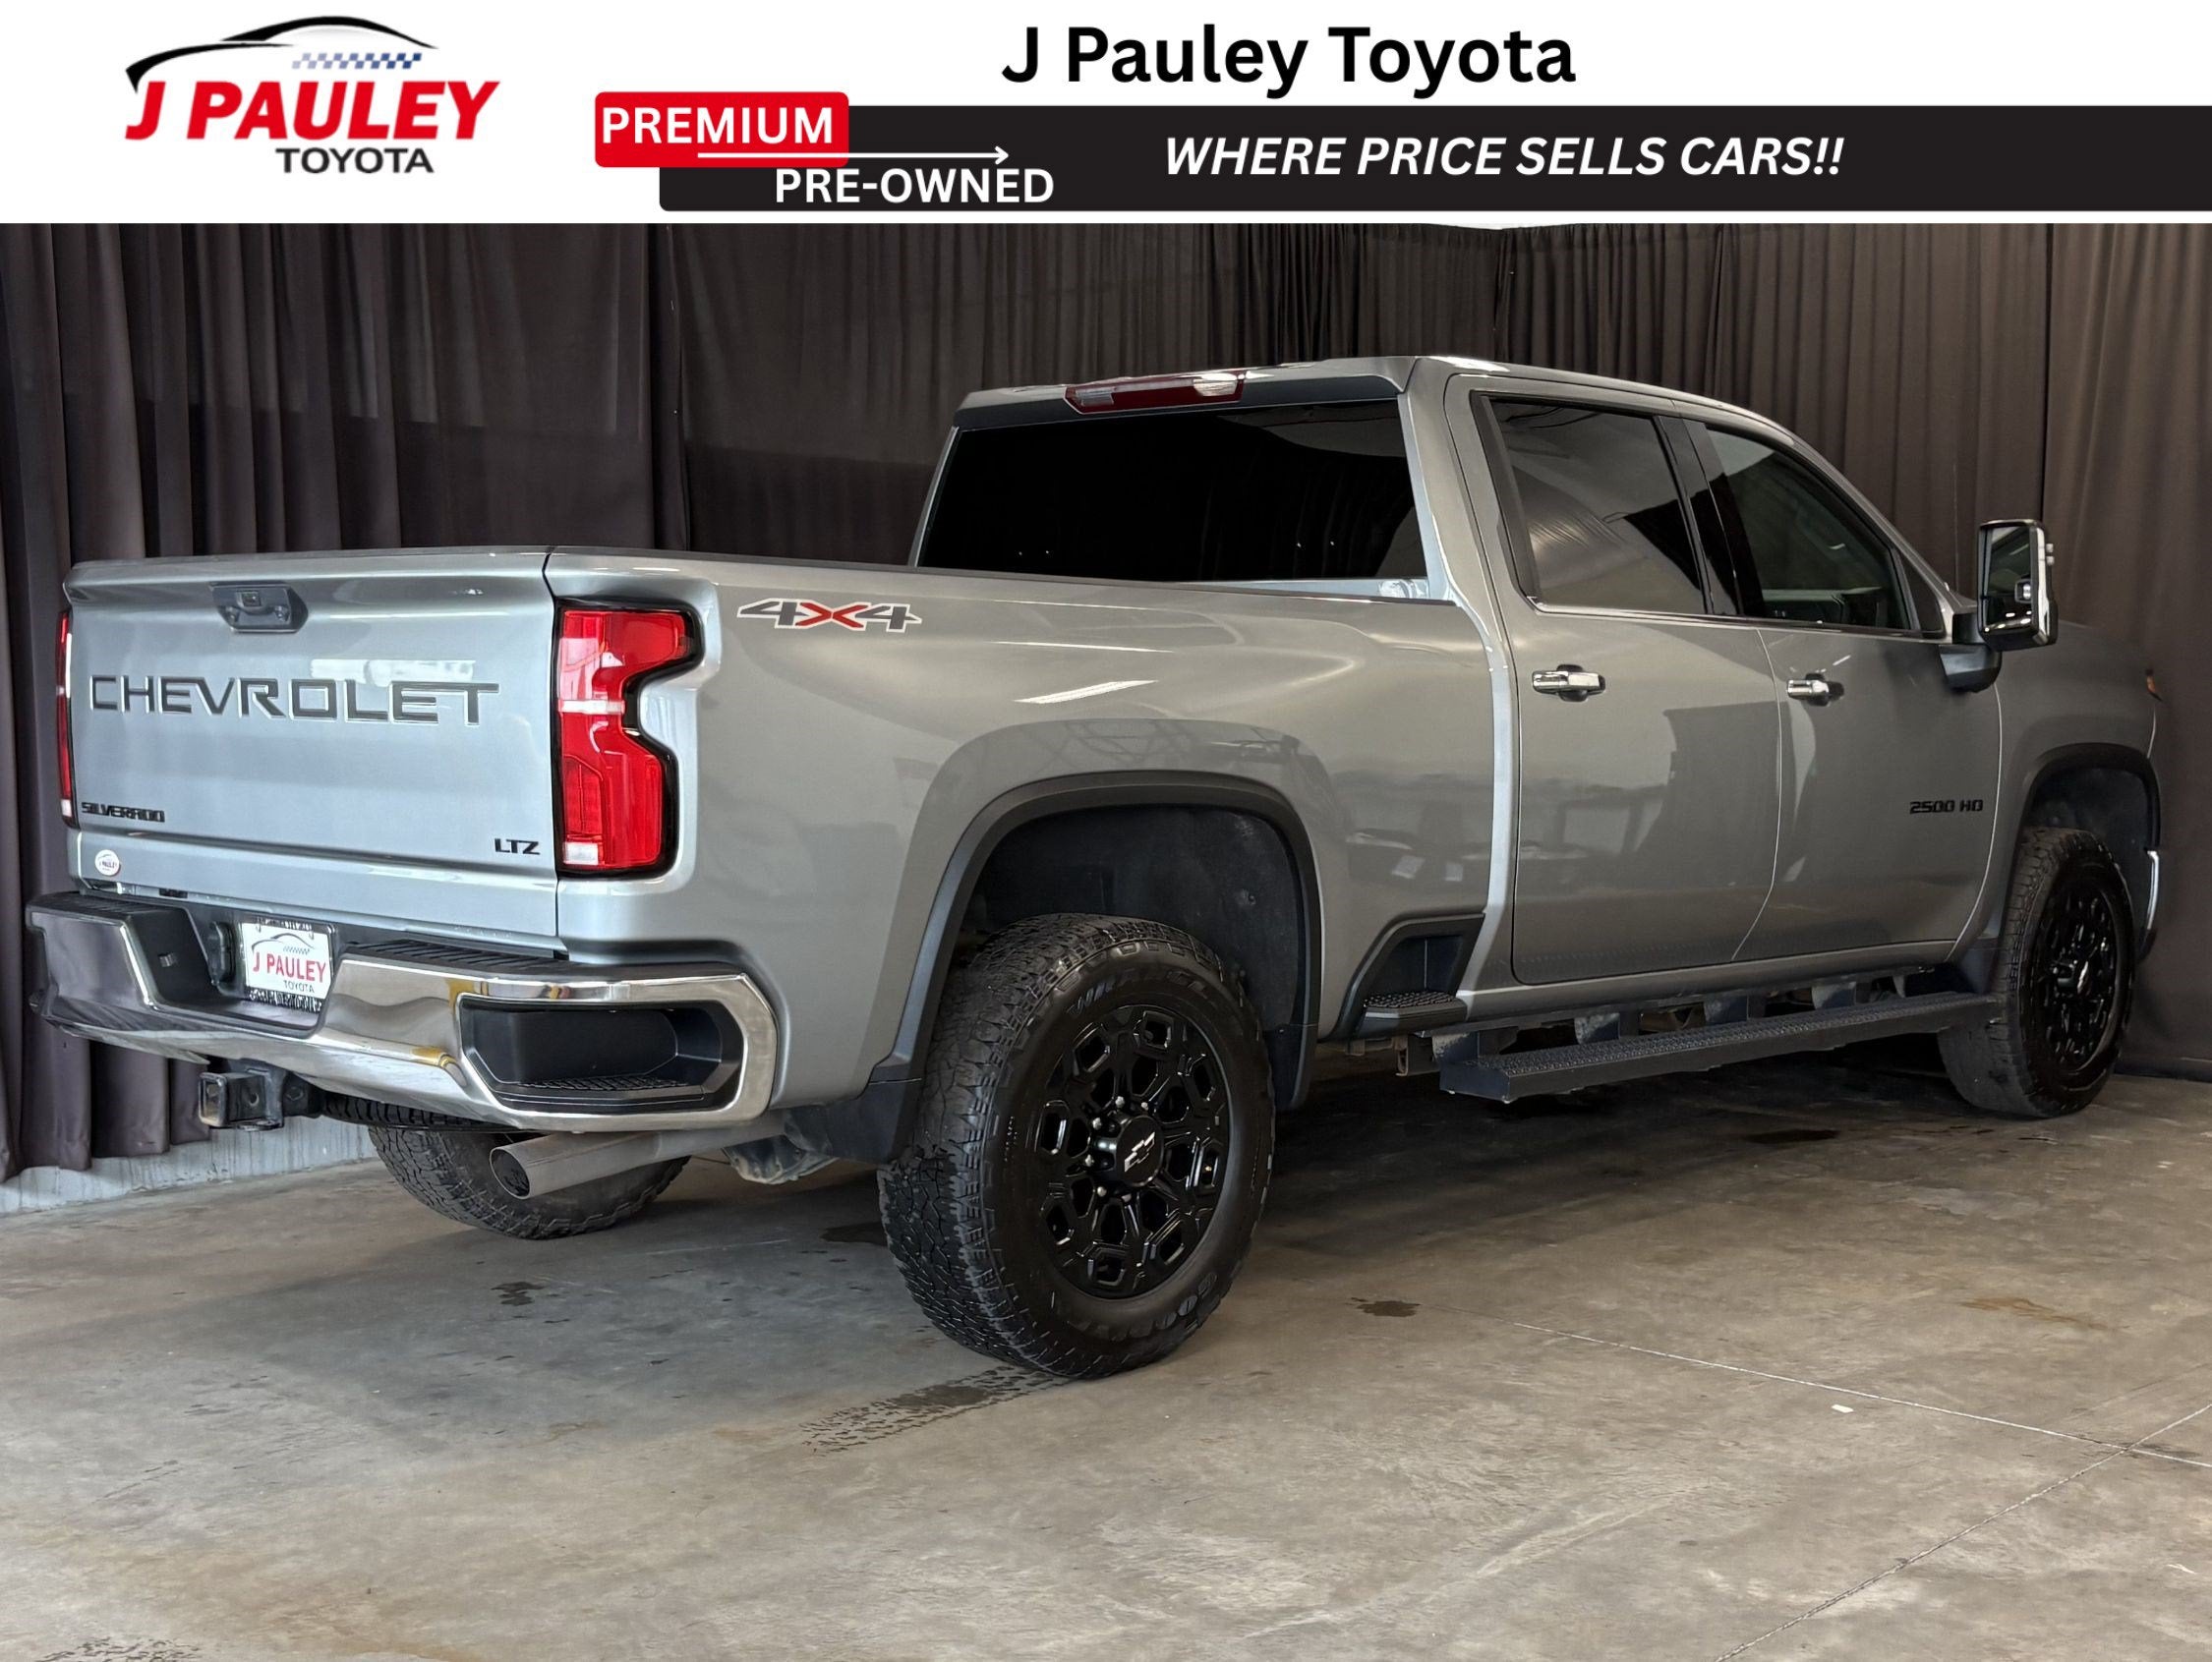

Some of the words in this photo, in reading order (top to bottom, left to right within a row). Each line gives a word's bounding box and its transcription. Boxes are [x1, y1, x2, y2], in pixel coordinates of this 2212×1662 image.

[90, 675, 499, 725] CHEVROLET
[82, 802, 165, 823] SILVERADO
[1910, 800, 1954, 814] 2500
[1959, 799, 1983, 812] HD
[495, 838, 541, 855] LTZ
[253, 951, 261, 972] J
[266, 953, 326, 983] PAULEY
[283, 980, 315, 994] TOYOTA
